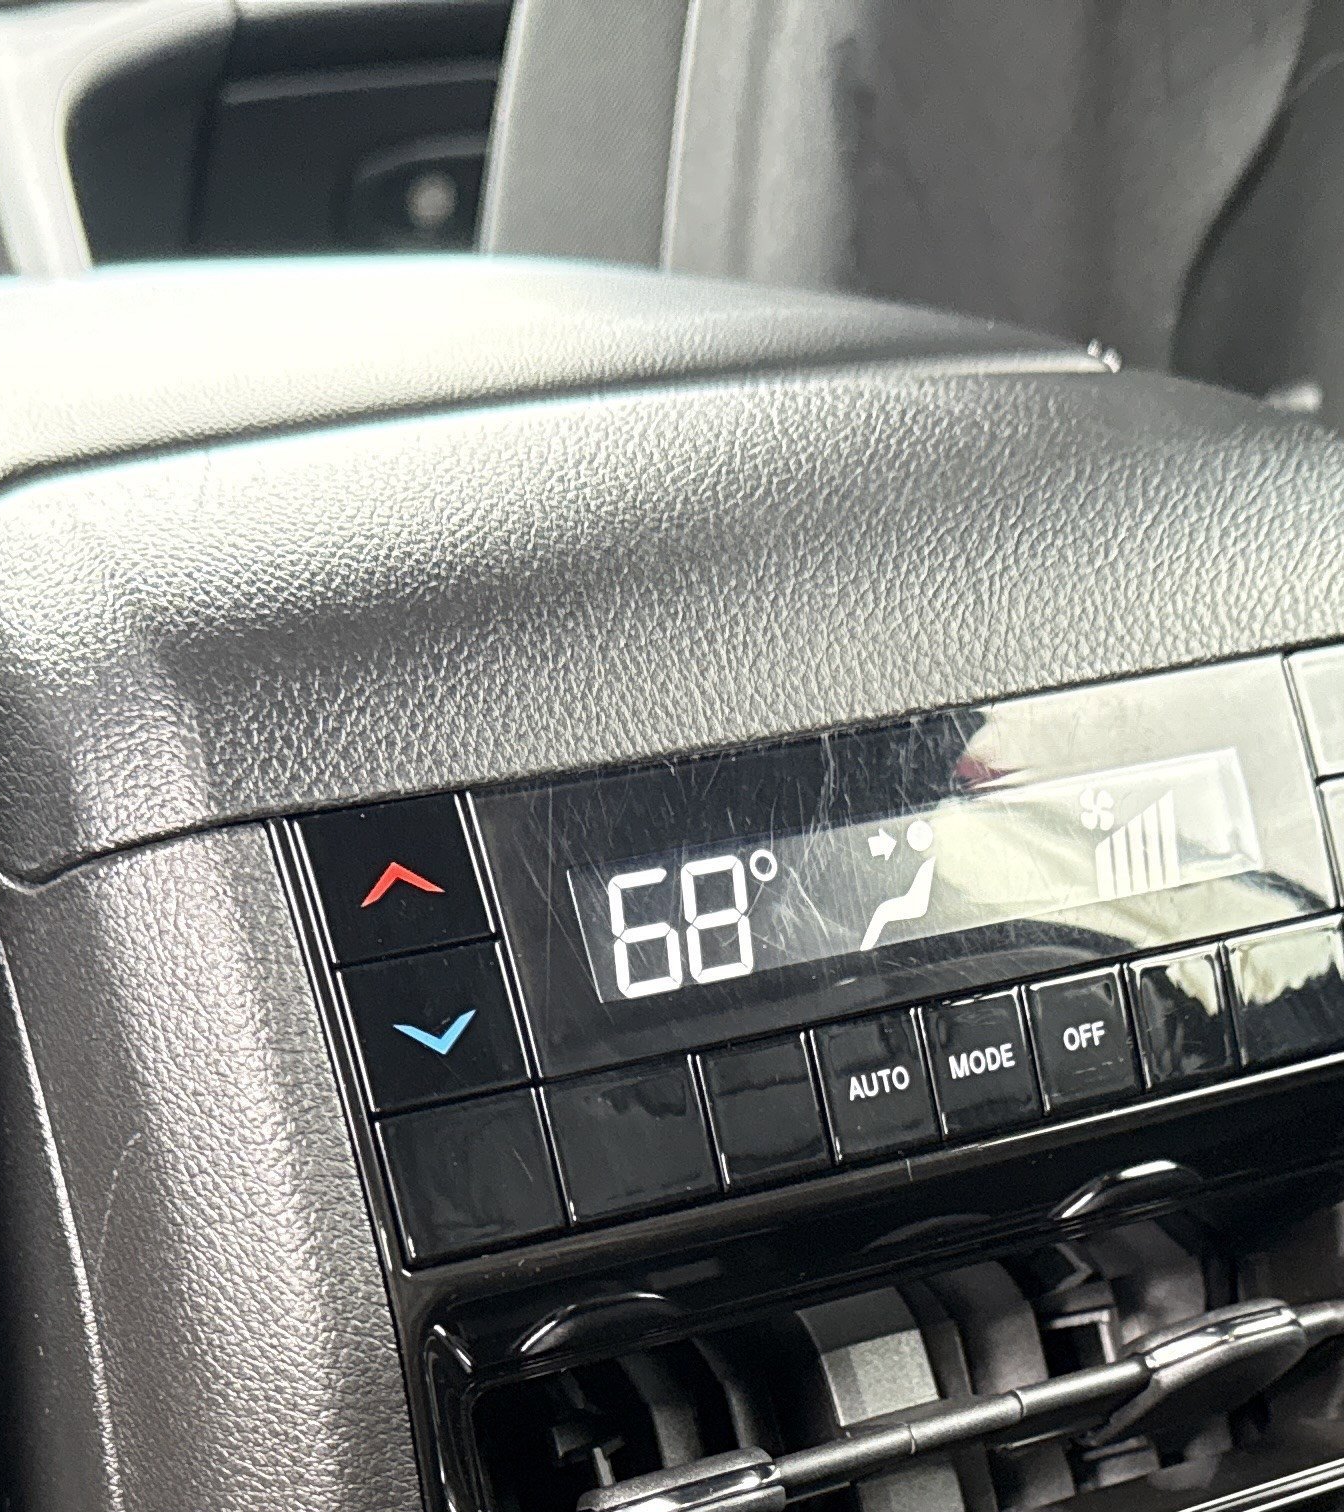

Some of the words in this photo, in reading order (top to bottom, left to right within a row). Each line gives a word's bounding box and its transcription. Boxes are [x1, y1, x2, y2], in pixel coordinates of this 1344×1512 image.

[1063, 1020, 1105, 1051] OFF
[948, 1043, 1016, 1080] MODE
[849, 1065, 910, 1101] AUTO
